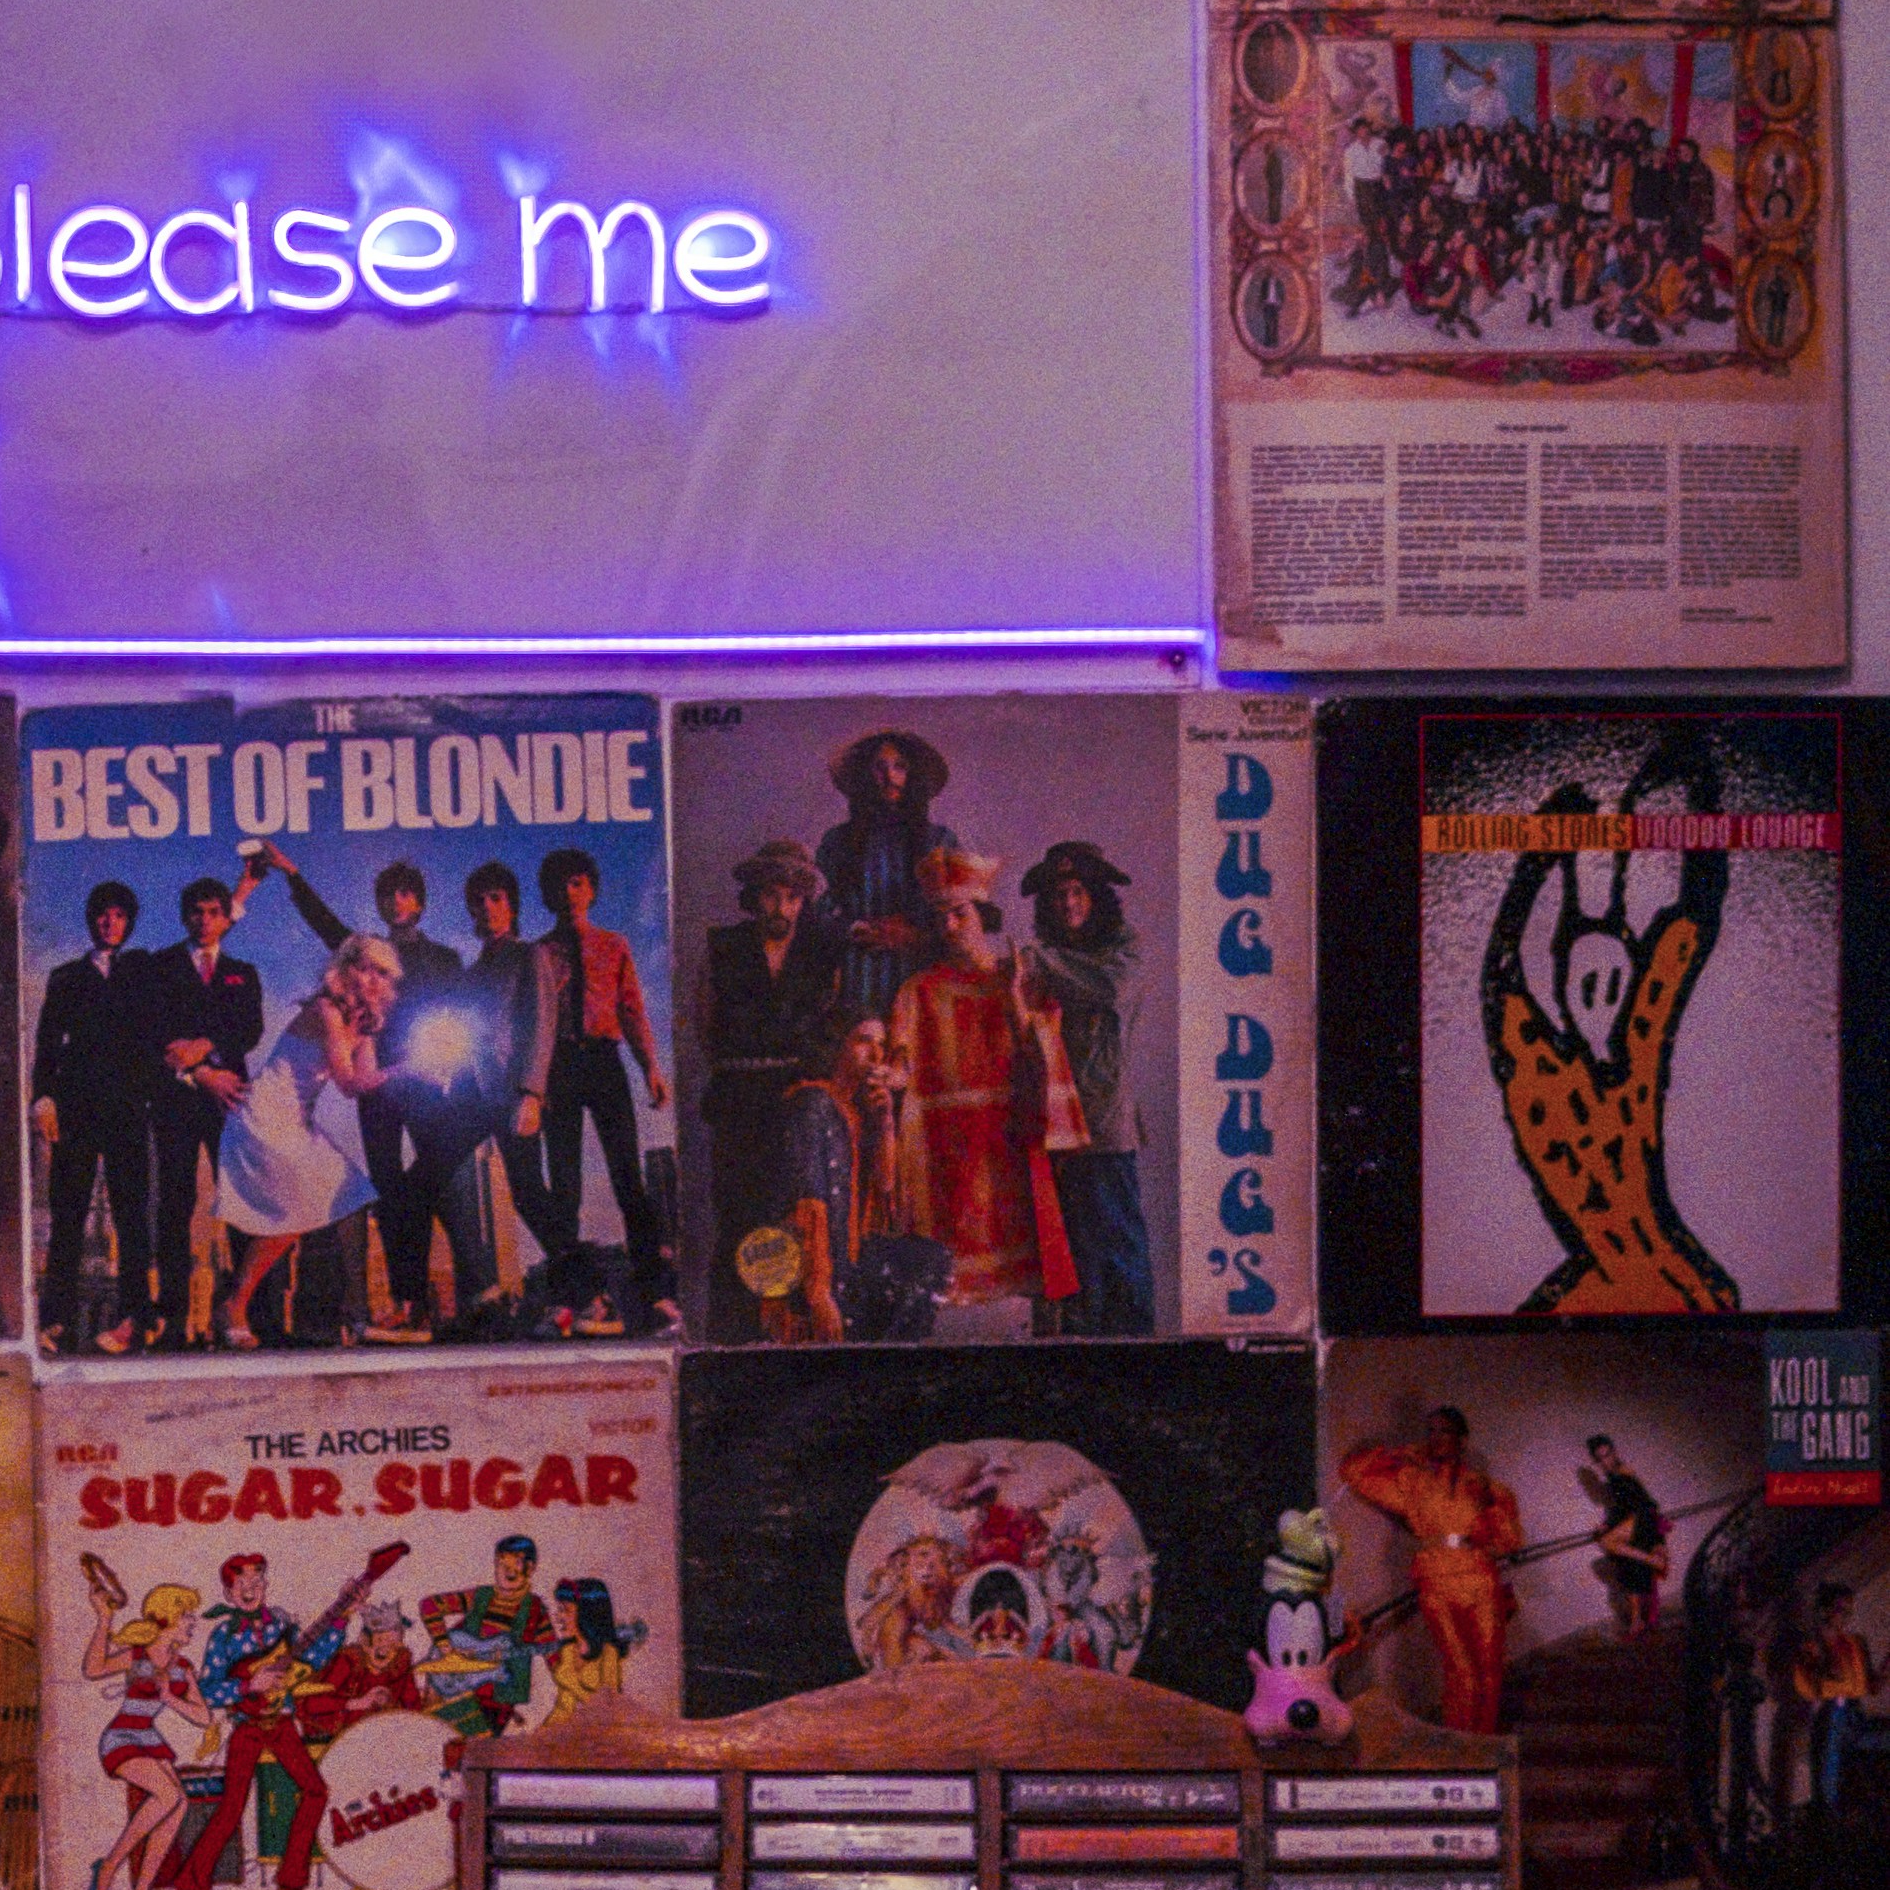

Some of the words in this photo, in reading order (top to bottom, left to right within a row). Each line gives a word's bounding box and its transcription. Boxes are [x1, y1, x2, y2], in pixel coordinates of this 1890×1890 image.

[520, 194, 772, 316] me
[313, 703, 356, 731] THE
[30, 740, 228, 844] BEST
[233, 738, 326, 838] OF
[341, 728, 652, 833] BLONDIE
[1437, 816, 1530, 850] ROLLING
[1539, 816, 1628, 850] STONES
[1636, 815, 1732, 850] VOODOO
[1740, 815, 1827, 850] LOUNGE
[1215, 752, 1274, 977] DUG
[1768, 1355, 1834, 1408] KOOL
[1837, 1374, 1871, 1407] AND
[245, 1434, 307, 1462] THE
[316, 1424, 453, 1458] ARCHIES
[1770, 1410, 1799, 1443] THE
[1800, 1410, 1872, 1462] GANG
[374, 1453, 639, 1514] SUGAR
[330, 1785, 439, 1848] Archies
